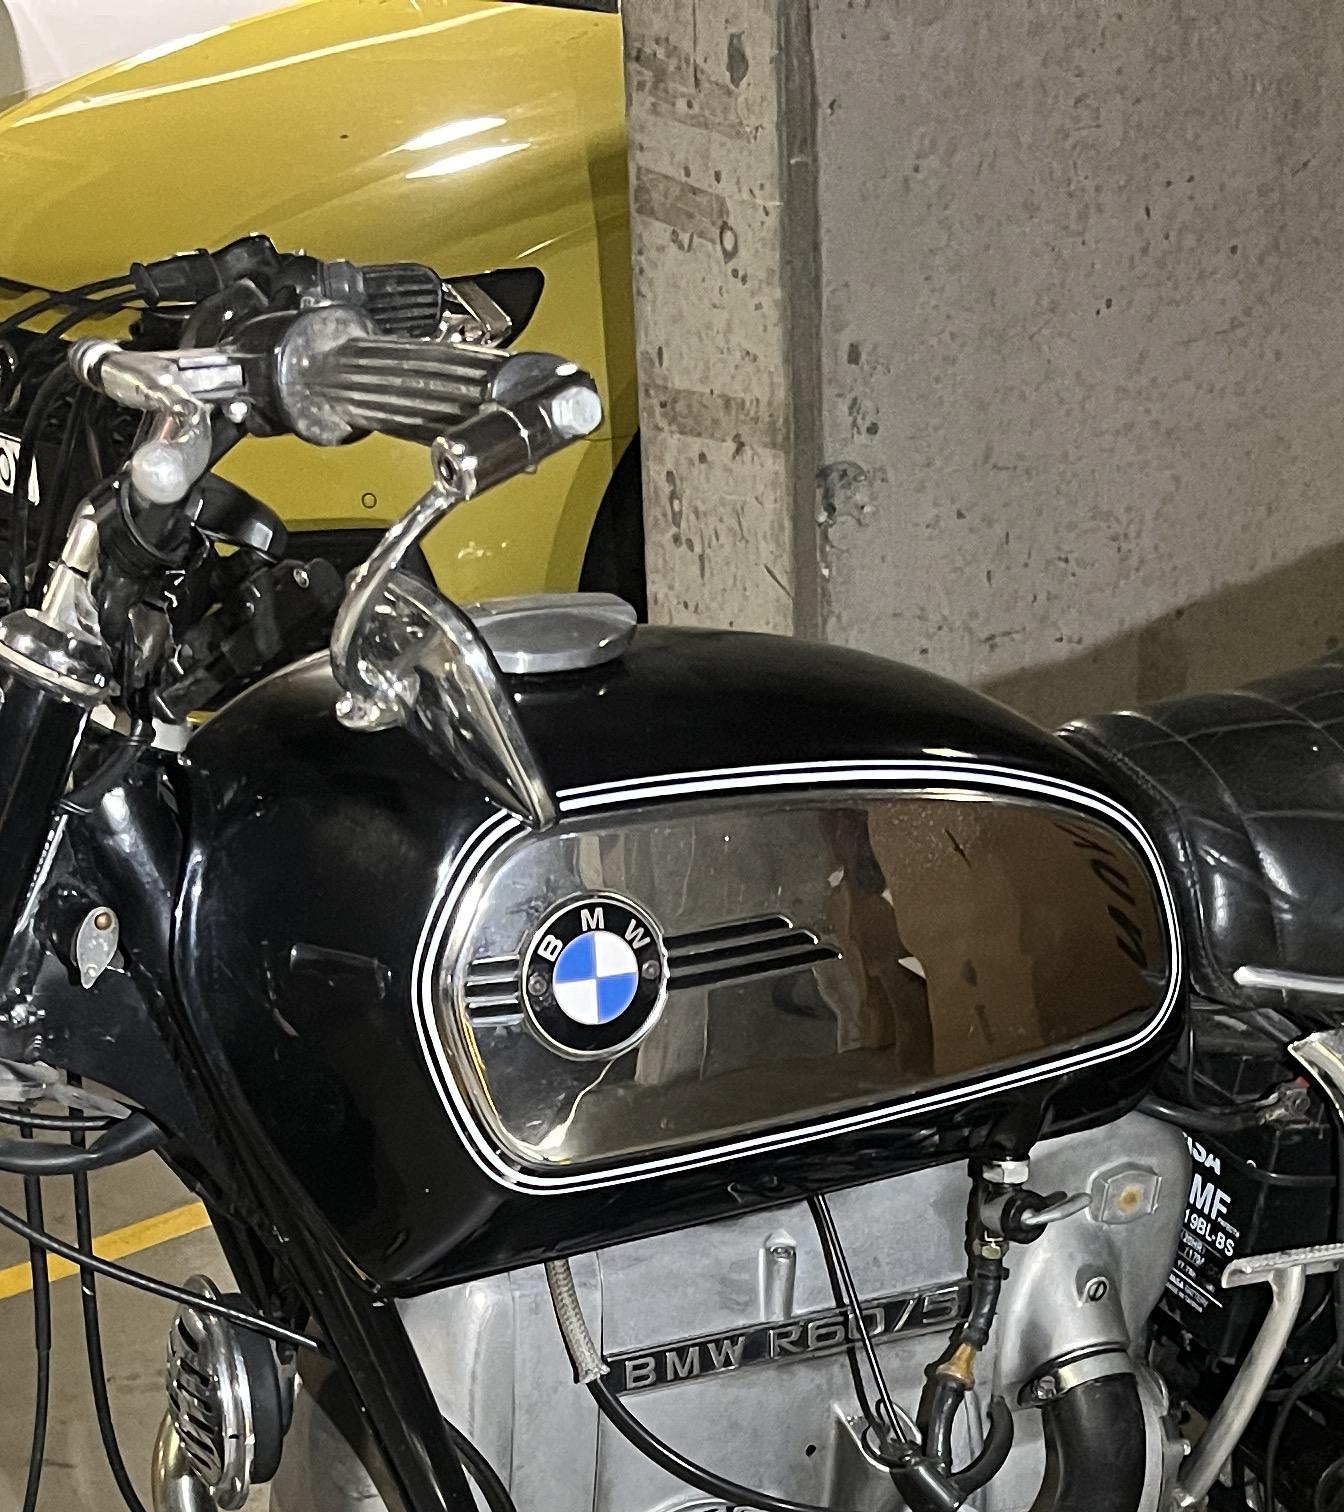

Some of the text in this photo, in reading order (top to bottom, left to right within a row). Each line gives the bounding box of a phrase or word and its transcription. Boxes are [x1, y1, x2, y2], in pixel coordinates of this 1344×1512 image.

[536, 906, 651, 963] BMW
[1189, 1172, 1232, 1220] MF
[624, 1286, 960, 1391] BMW R60/5
